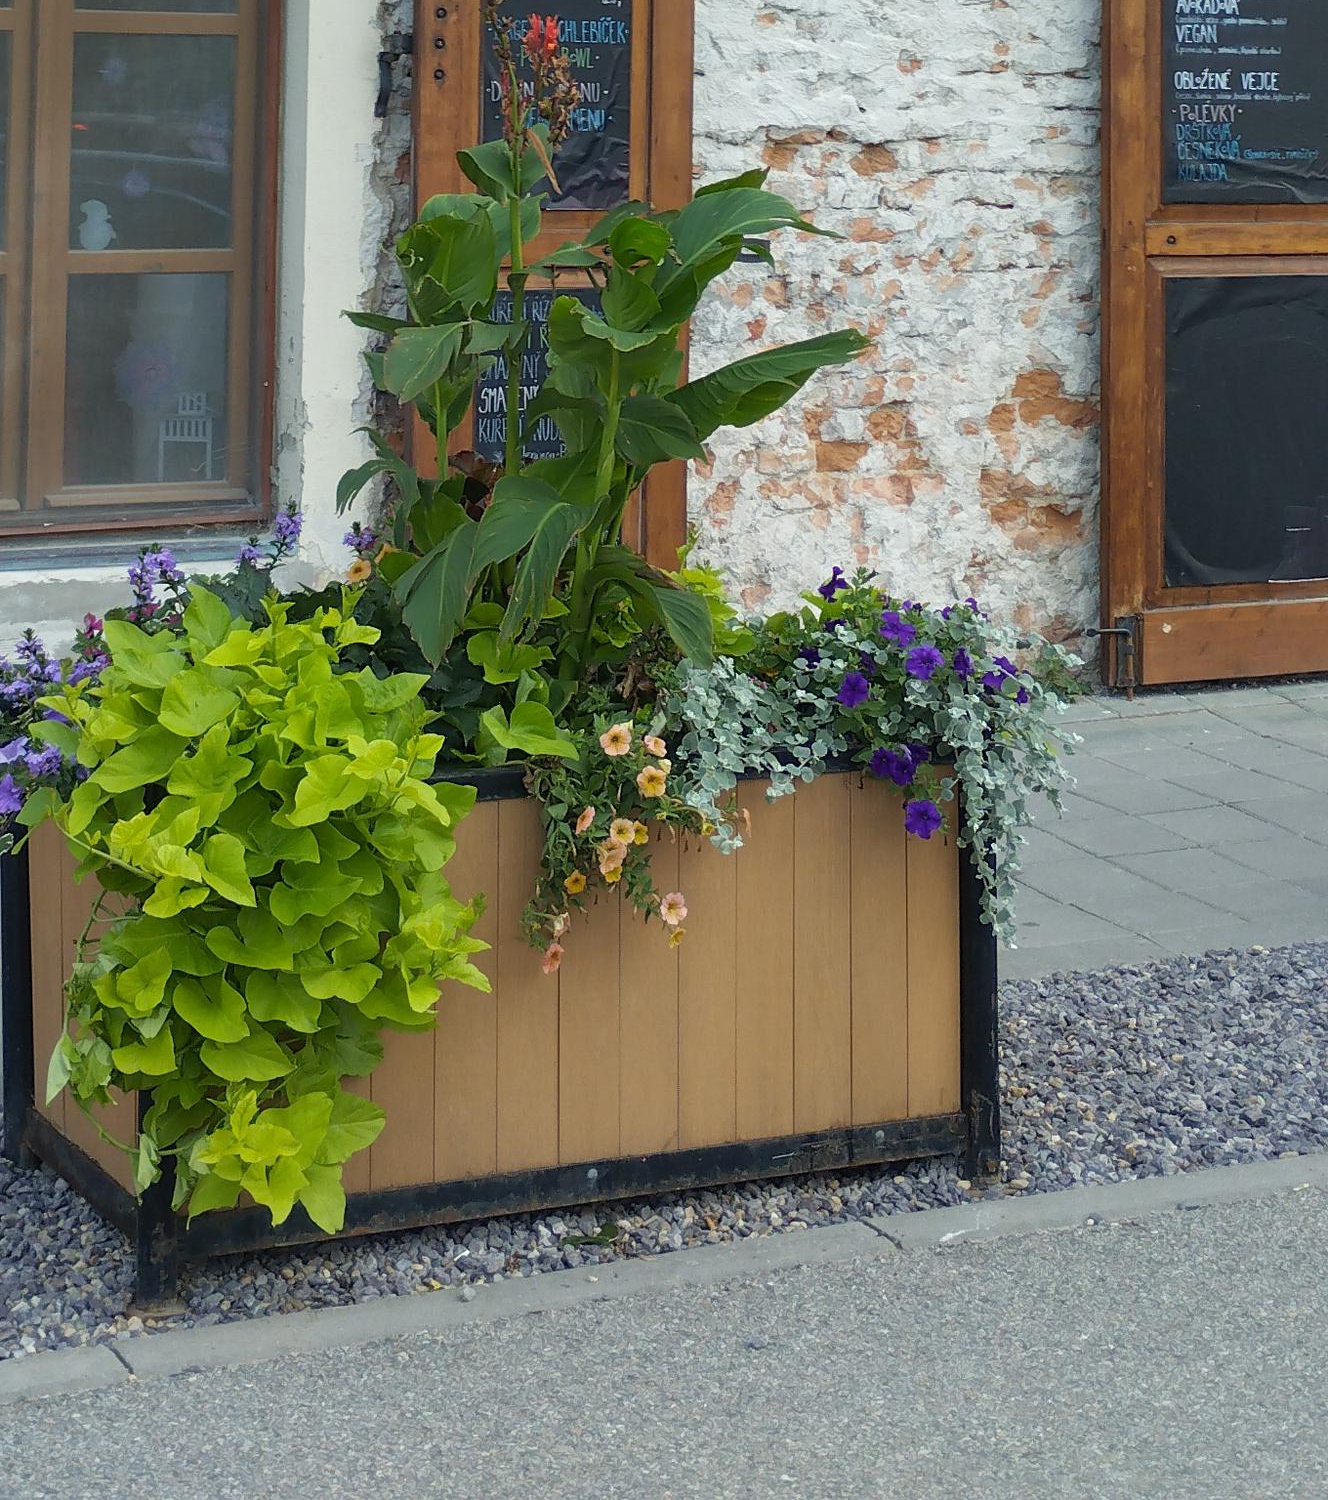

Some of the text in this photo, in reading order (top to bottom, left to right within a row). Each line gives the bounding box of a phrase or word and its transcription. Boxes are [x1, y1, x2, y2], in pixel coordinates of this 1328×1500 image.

[558, 16, 626, 44] CHLEBÍČEK
[1175, 24, 1218, 43] VEGAN
[1240, 71, 1280, 91] VEJCE
